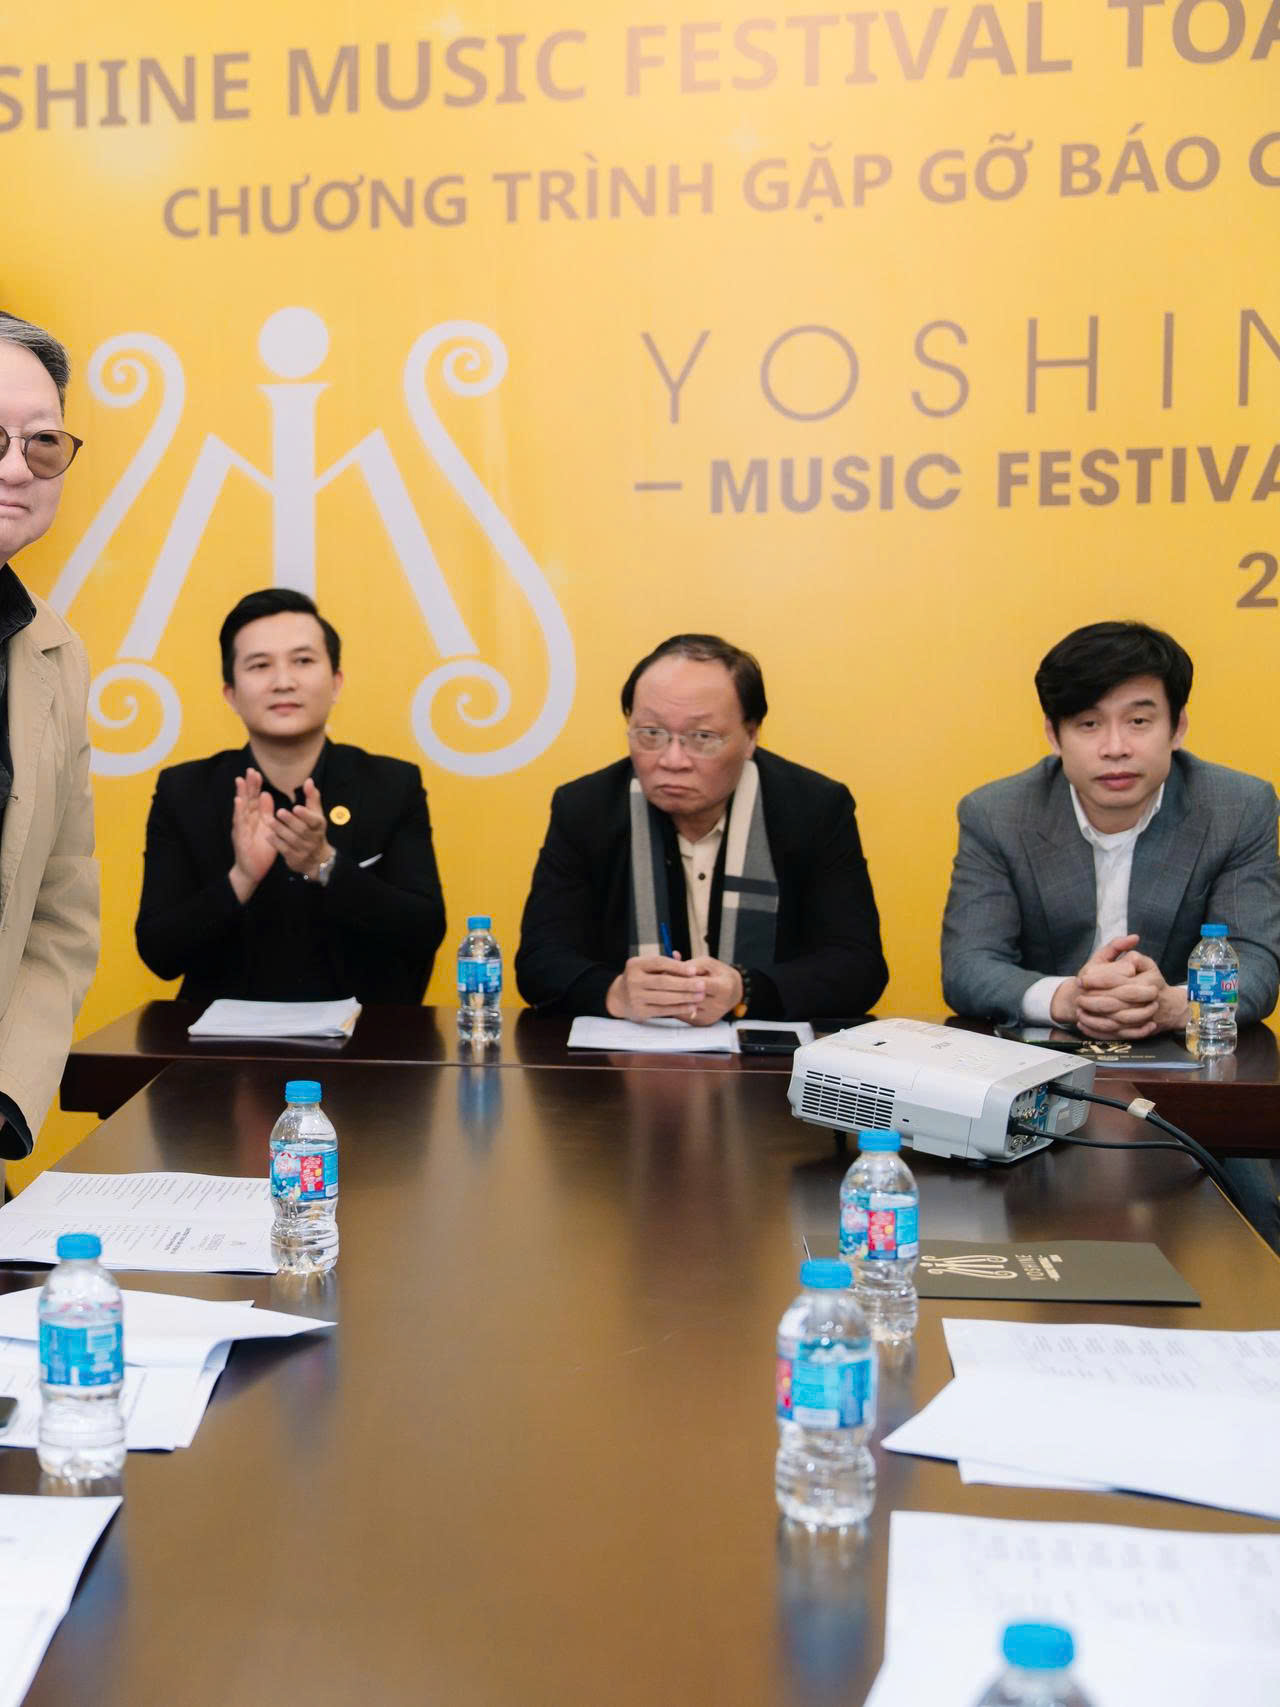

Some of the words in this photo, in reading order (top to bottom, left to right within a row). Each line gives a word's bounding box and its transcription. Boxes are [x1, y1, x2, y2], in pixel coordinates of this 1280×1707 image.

[287, 29, 588, 117] MUSIC
[624, 1, 1073, 97] FESTIVAL
[163, 174, 468, 239] CHƯƠNG
[492, 151, 715, 223] TRÌNH
[742, 141, 893, 223] GẶP
[919, 131, 1034, 204] GỠ
[1058, 121, 1221, 198] BÁO
[709, 452, 963, 515] MUSIC
